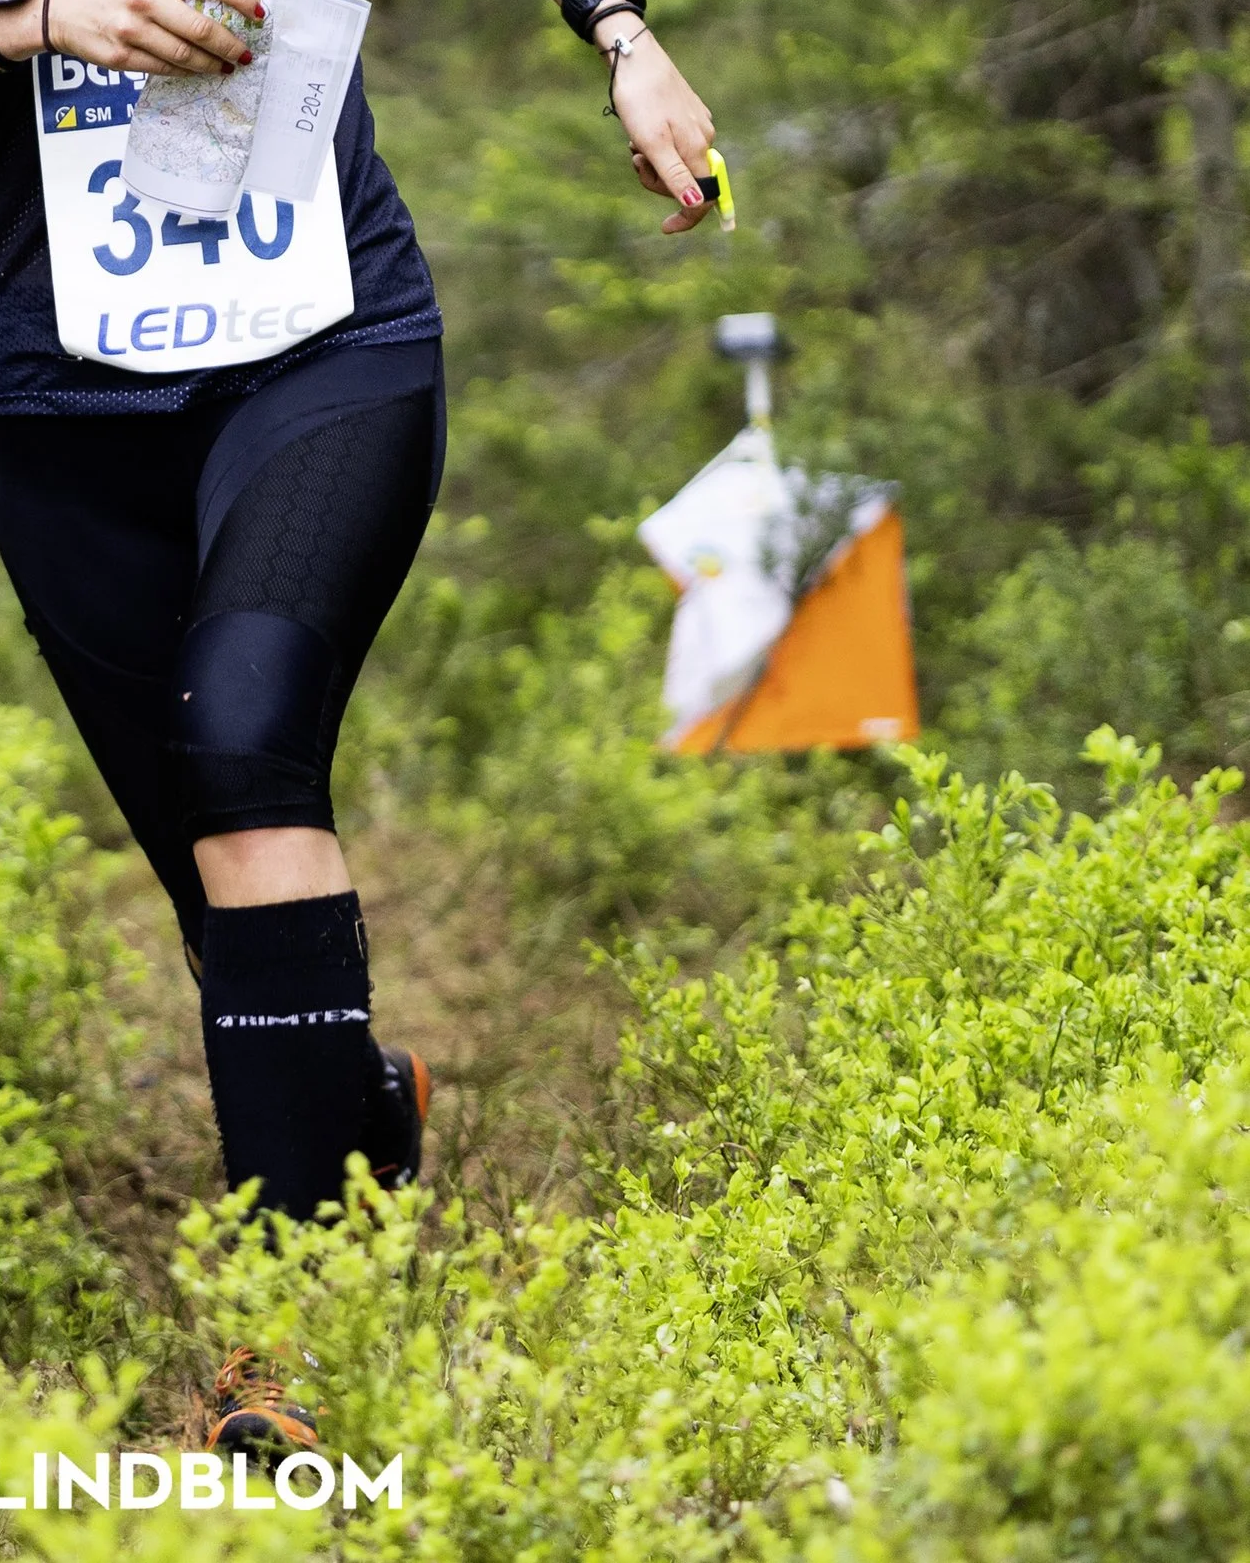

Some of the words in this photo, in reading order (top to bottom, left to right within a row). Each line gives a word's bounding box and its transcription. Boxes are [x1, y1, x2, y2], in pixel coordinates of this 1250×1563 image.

[301, 81, 326, 117] 20-A
[85, 106, 112, 123] SM
[295, 118, 314, 133] D
[87, 159, 295, 276] 340
